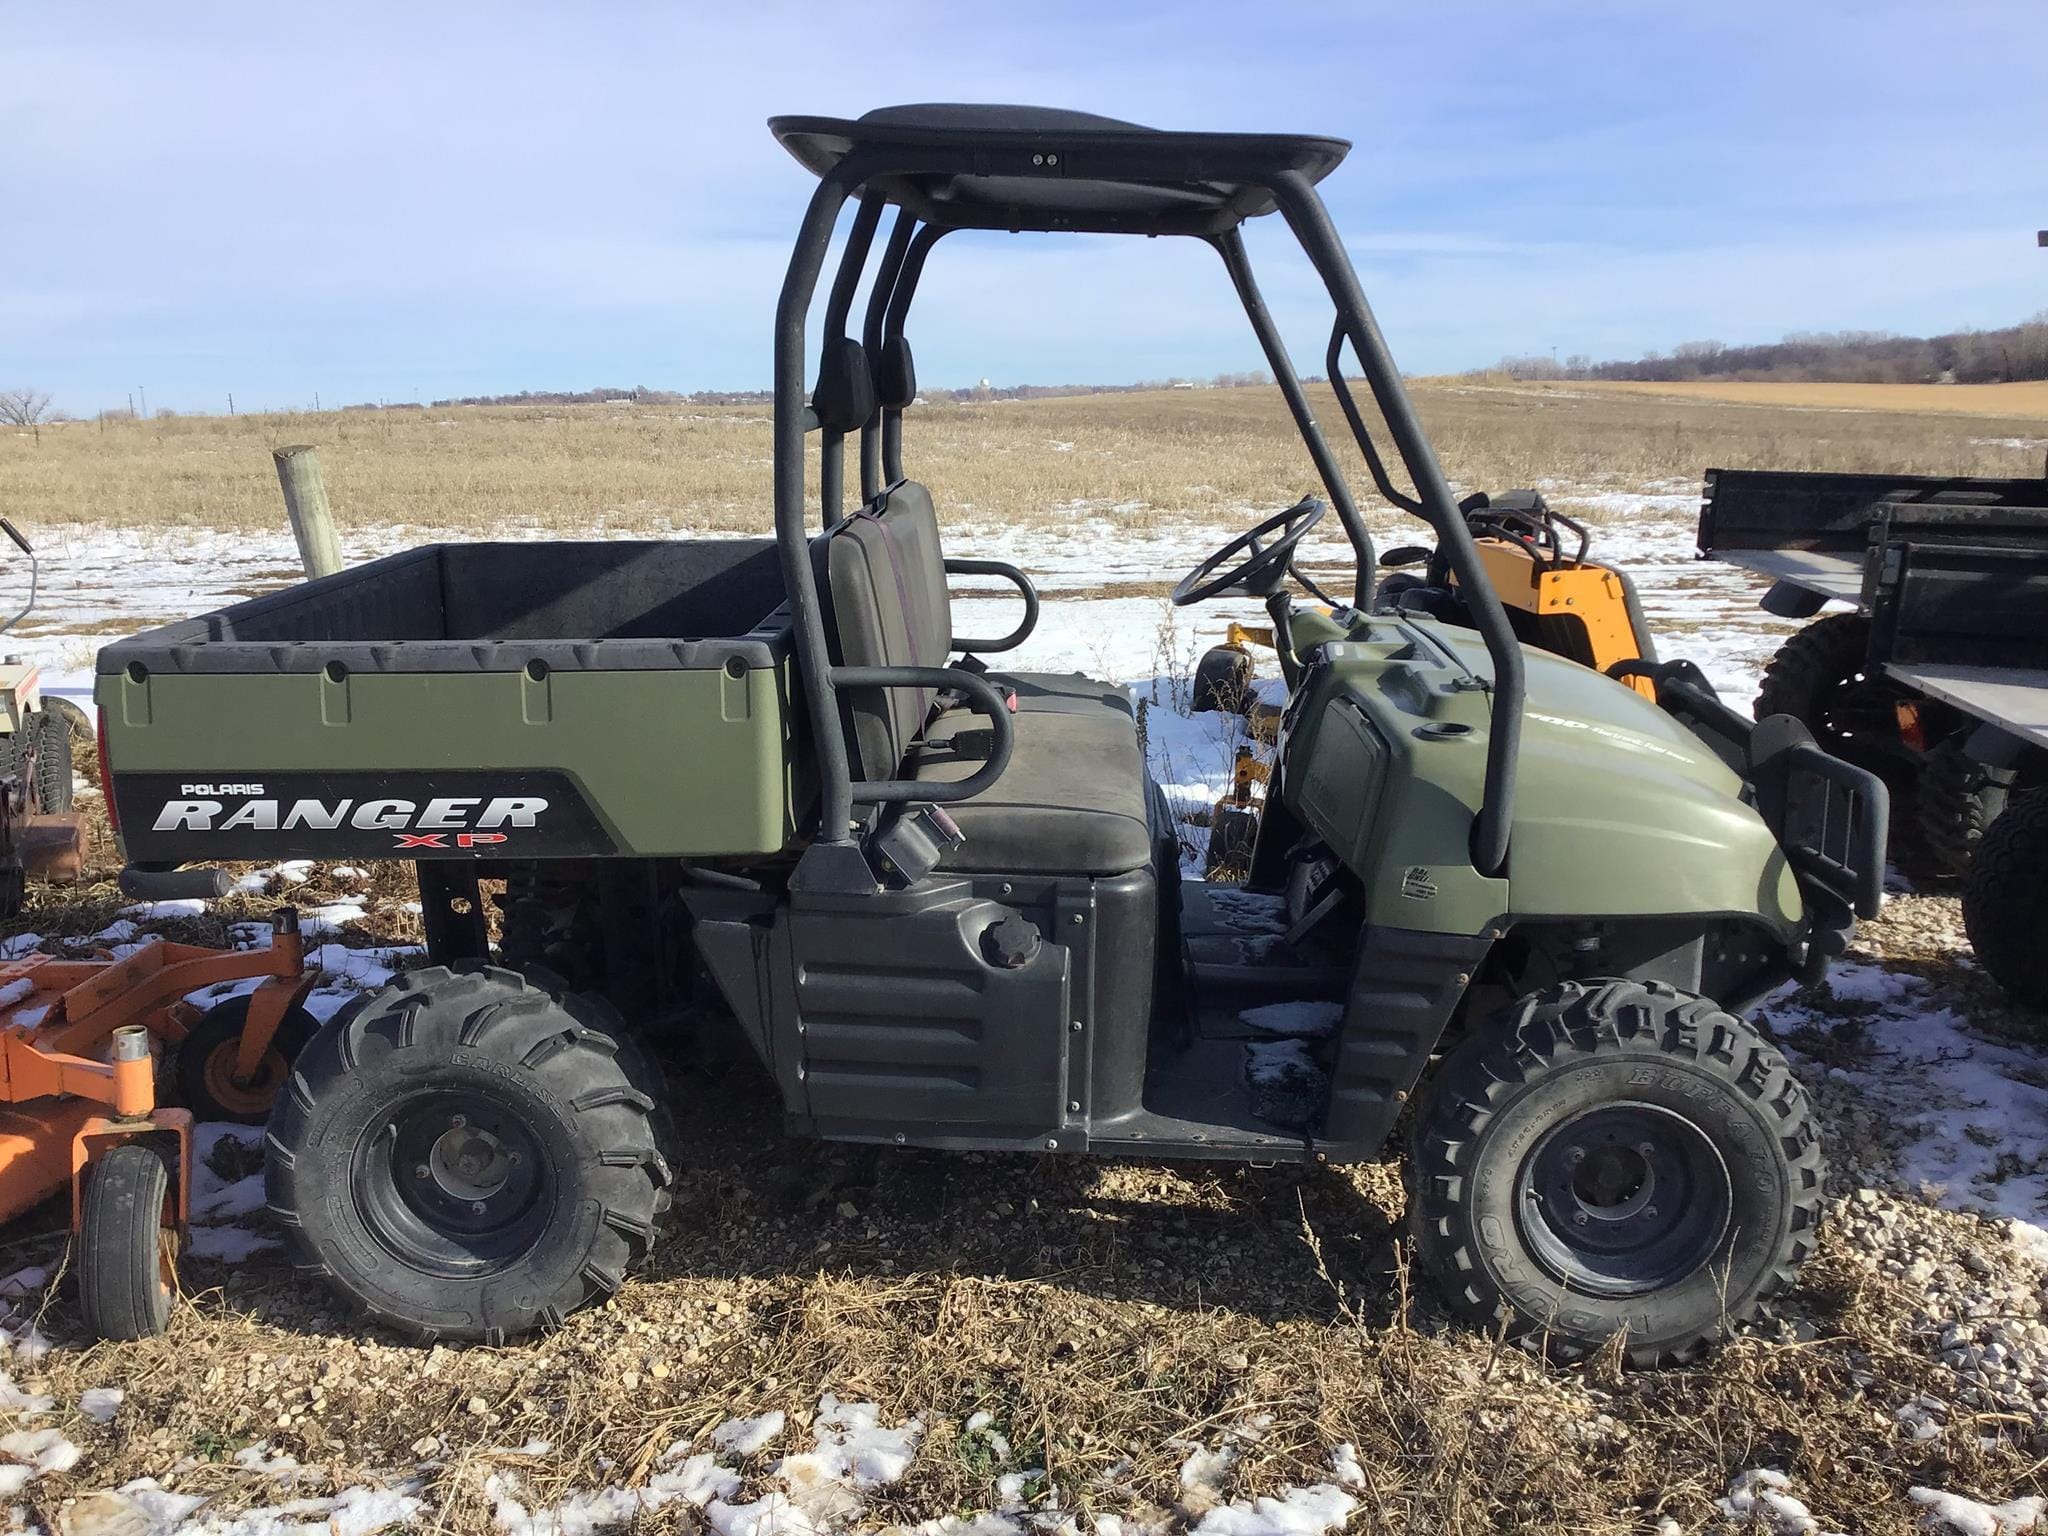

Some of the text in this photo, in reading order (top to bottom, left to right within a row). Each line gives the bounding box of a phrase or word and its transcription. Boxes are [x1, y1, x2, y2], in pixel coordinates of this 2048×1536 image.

[151, 797, 549, 831] RANGER
[180, 783, 265, 796] POLARIS
[392, 833, 508, 849] XP
[450, 1051, 580, 1137] CARLISLE
[1627, 1067, 1776, 1193] BUFFALO
[1477, 1214, 1607, 1333] DURO
